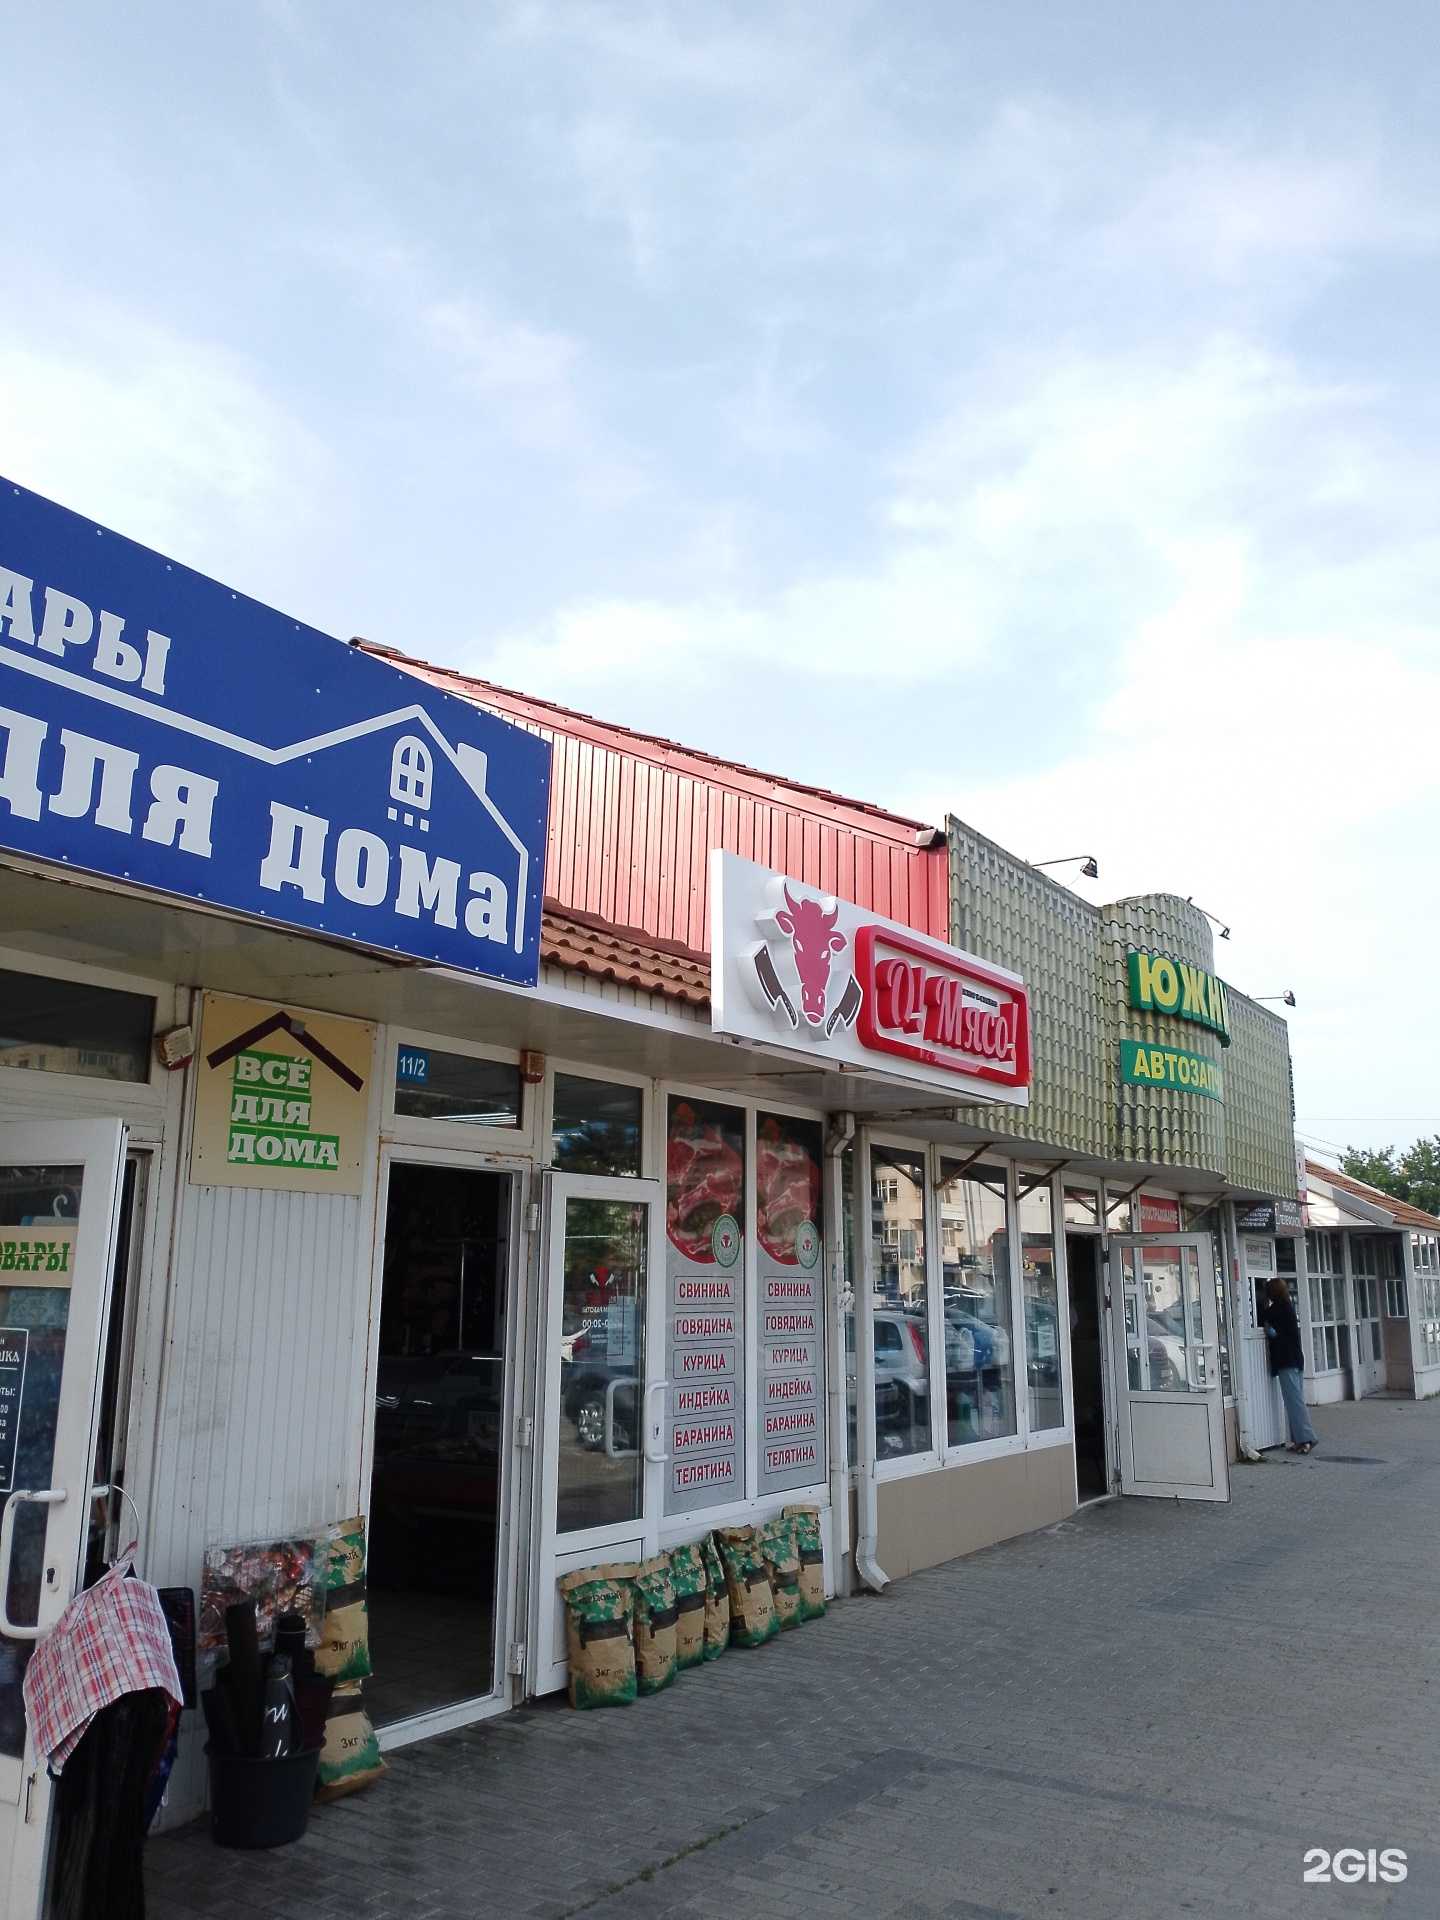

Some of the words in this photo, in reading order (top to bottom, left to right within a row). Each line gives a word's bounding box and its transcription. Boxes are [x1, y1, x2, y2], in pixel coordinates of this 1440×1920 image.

[259, 800, 508, 945] дома
[236, 1055, 311, 1089] ВСЁ
[400, 1055, 426, 1077] 11/2
[232, 1094, 311, 1126] ДЛЯ
[228, 1133, 339, 1165] ДОМА
[0, 1241, 70, 1271] ВАРЫ
[679, 1282, 730, 1298] СВИНИНА
[768, 1282, 812, 1297] СВИНИНА
[676, 1318, 733, 1336] ГОВЯДИНА
[765, 1314, 814, 1330] ГОВЯДИНА
[683, 1353, 726, 1372] КУРИЦА
[772, 1348, 809, 1364] КУРИЦА
[678, 1387, 730, 1410] ИНДЕЙКА
[769, 1378, 812, 1398] ИНДЕЙКА
[766, 1413, 815, 1433] БАРАНИНА
[675, 1424, 733, 1448] БАРАНИНА
[767, 1446, 815, 1468] ТЕЛЯТИНА
[676, 1461, 732, 1485] ТЕЛЯТИНА
